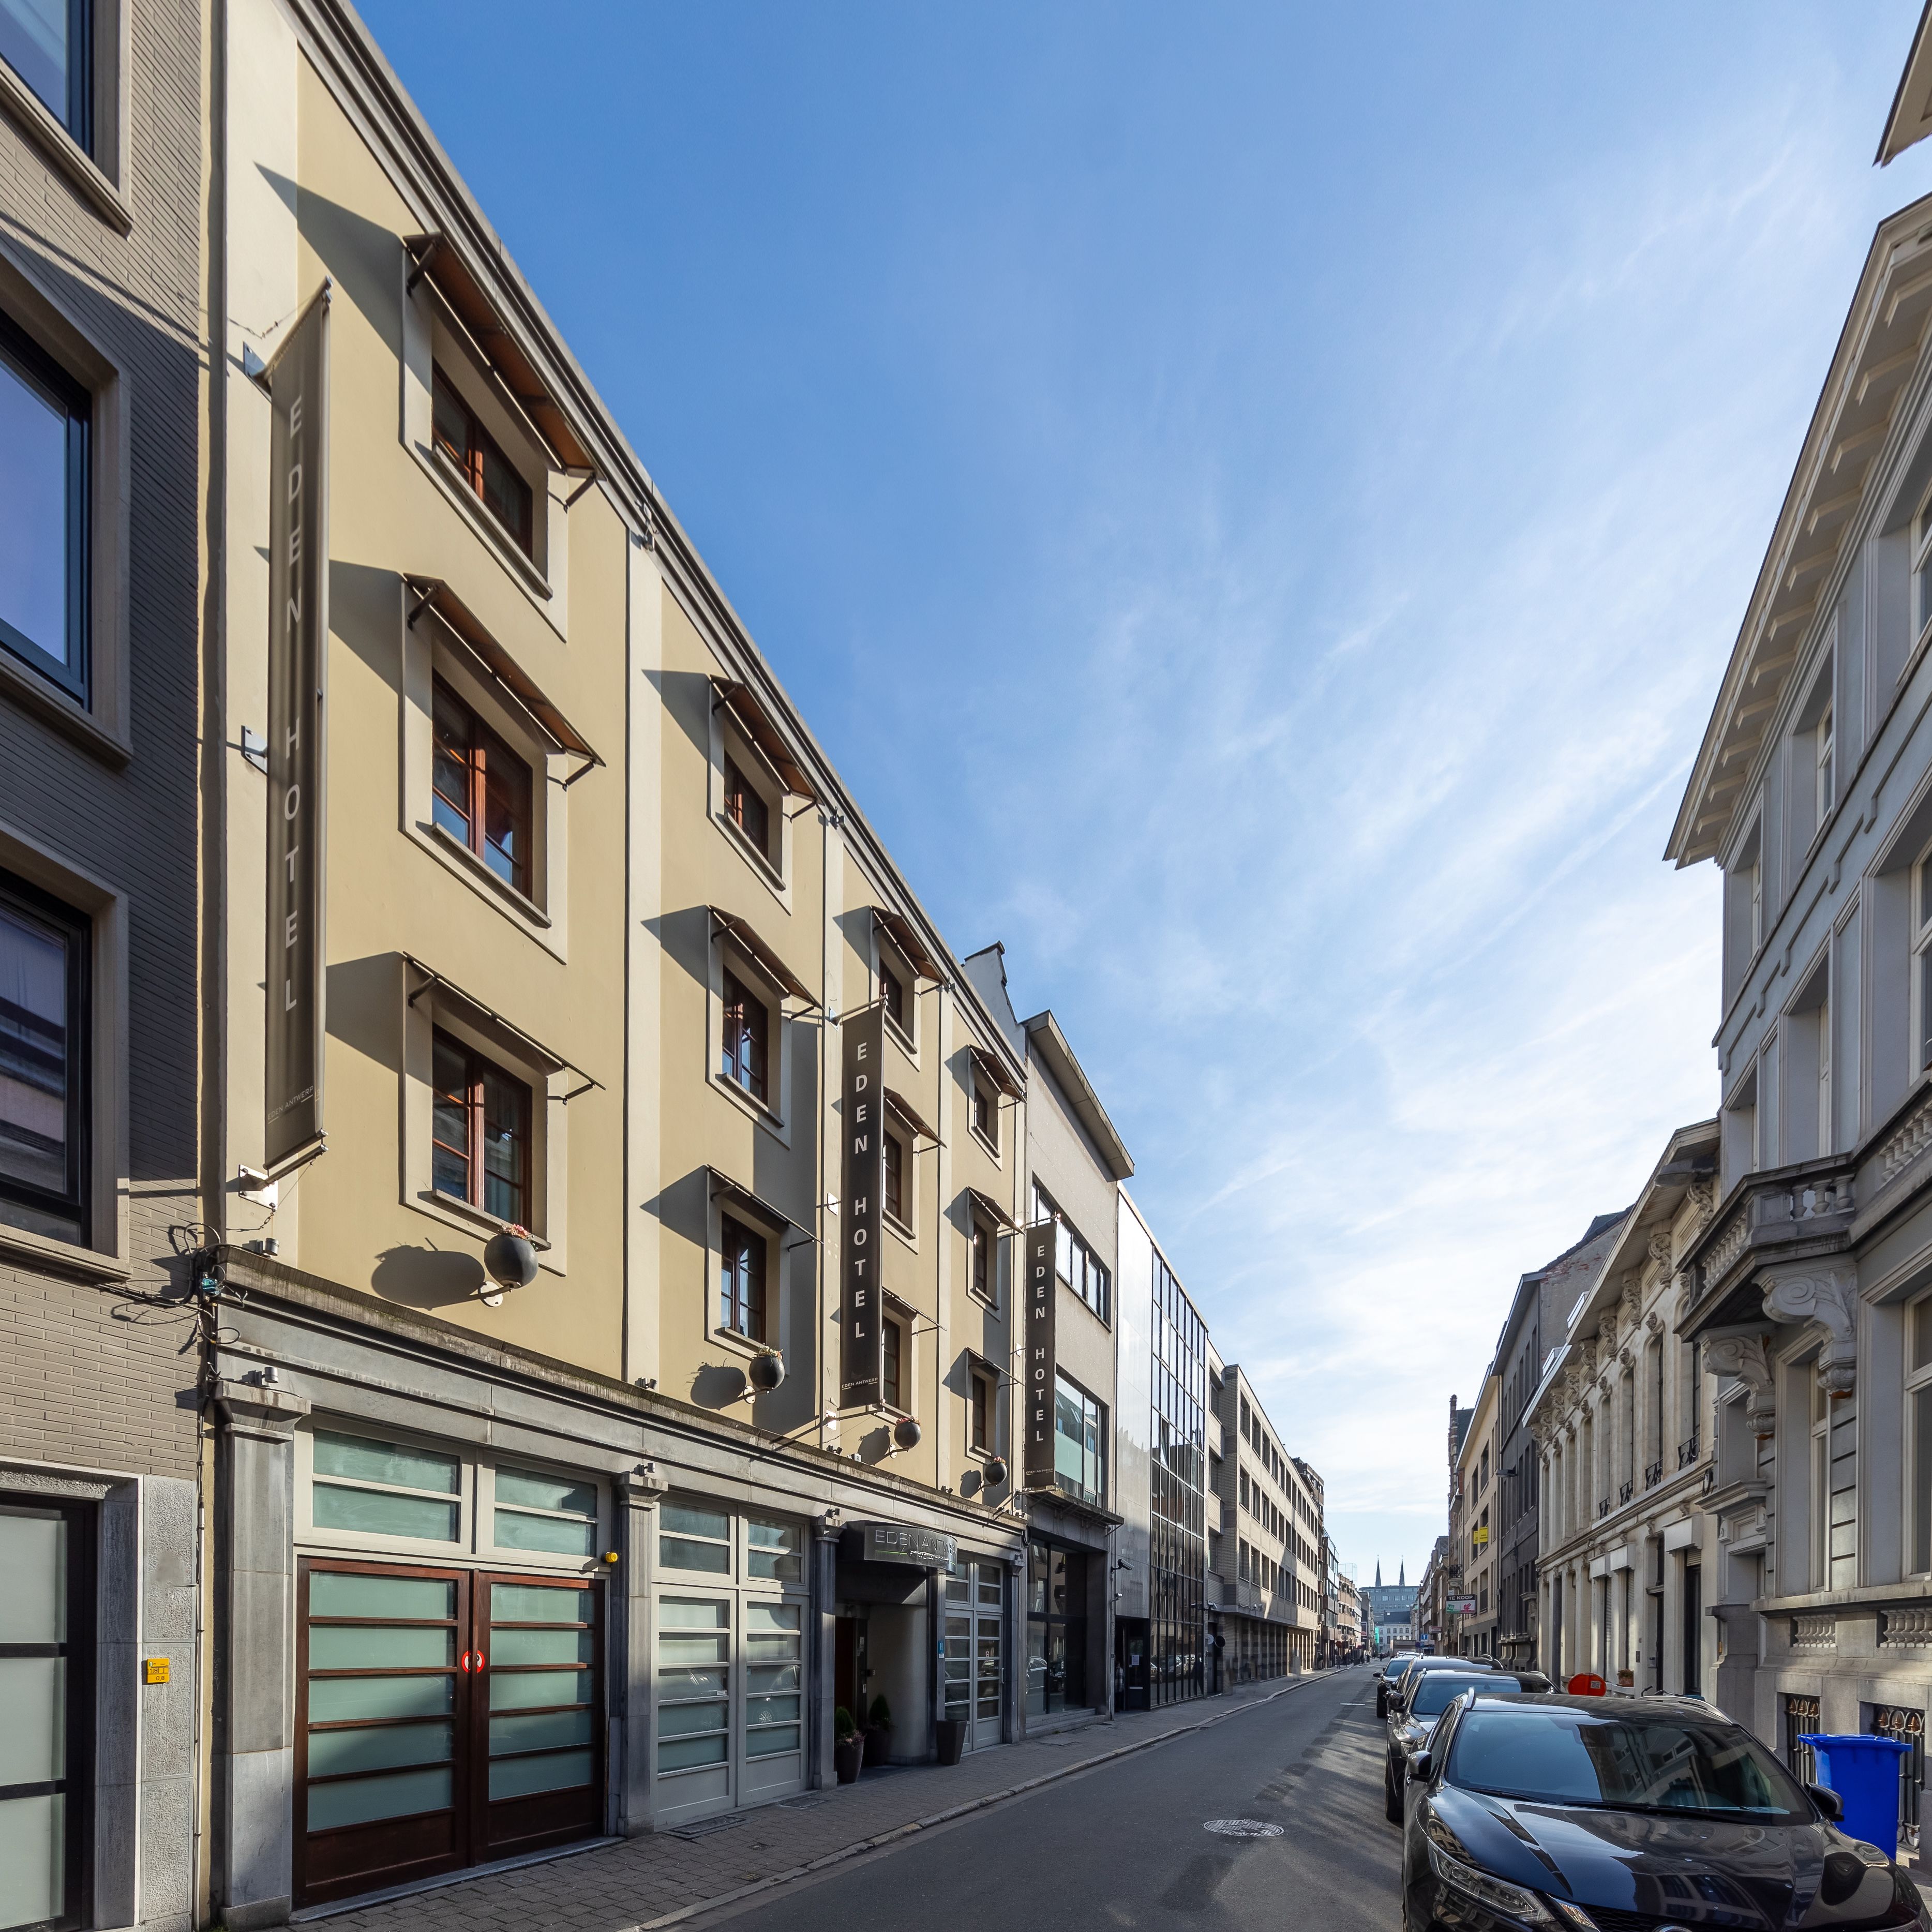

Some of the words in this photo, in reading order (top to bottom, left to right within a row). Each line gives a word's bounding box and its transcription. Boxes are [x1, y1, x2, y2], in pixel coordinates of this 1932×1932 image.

[287, 395, 302, 633] EDEN
[284, 716, 300, 1011] HOTEL
[267, 1105, 283, 1120] EDEN
[285, 1085, 313, 1109] ANTWERP
[855, 1042, 867, 1154] EDEN
[854, 1197, 866, 1338] HOTEL
[1036, 1245, 1045, 1319] EDEN
[856, 1377, 878, 1385] ANTWERP
[1035, 1348, 1045, 1442] HOTEL
[875, 1530, 919, 1547] EDEN
